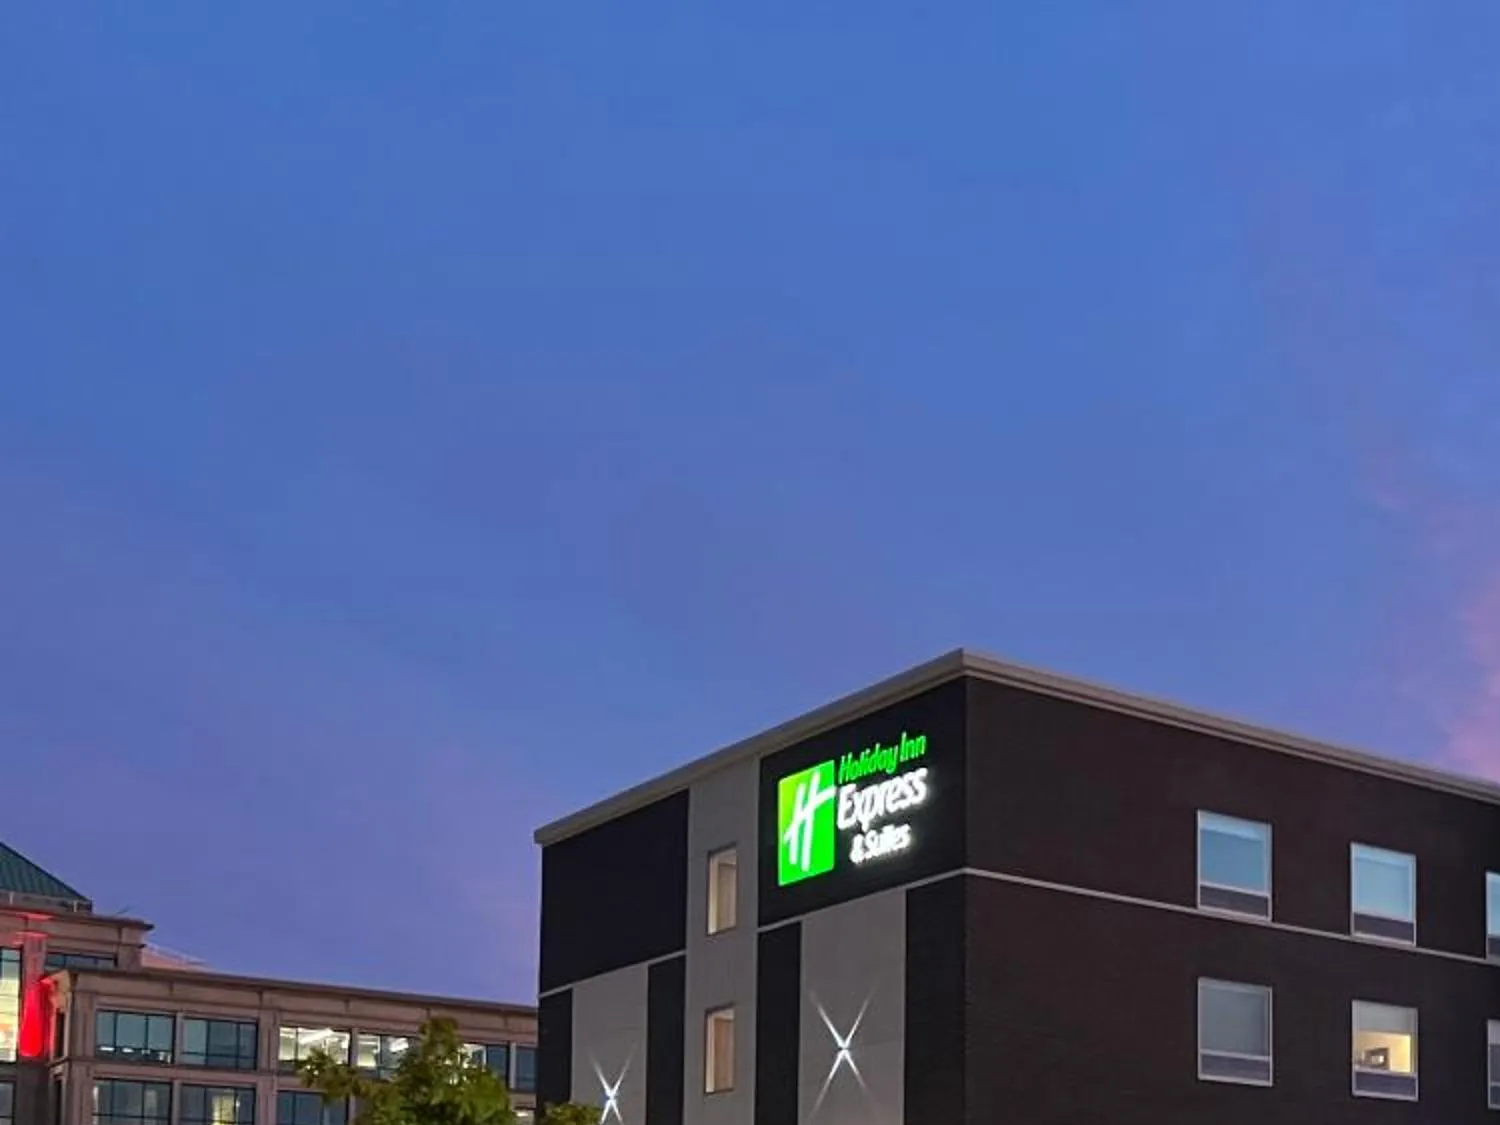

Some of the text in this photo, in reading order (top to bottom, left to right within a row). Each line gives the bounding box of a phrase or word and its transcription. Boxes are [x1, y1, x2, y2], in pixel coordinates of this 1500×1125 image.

[838, 731, 927, 784] Holiday Inn
[836, 767, 929, 832] Express
[849, 824, 911, 864] & Suites
